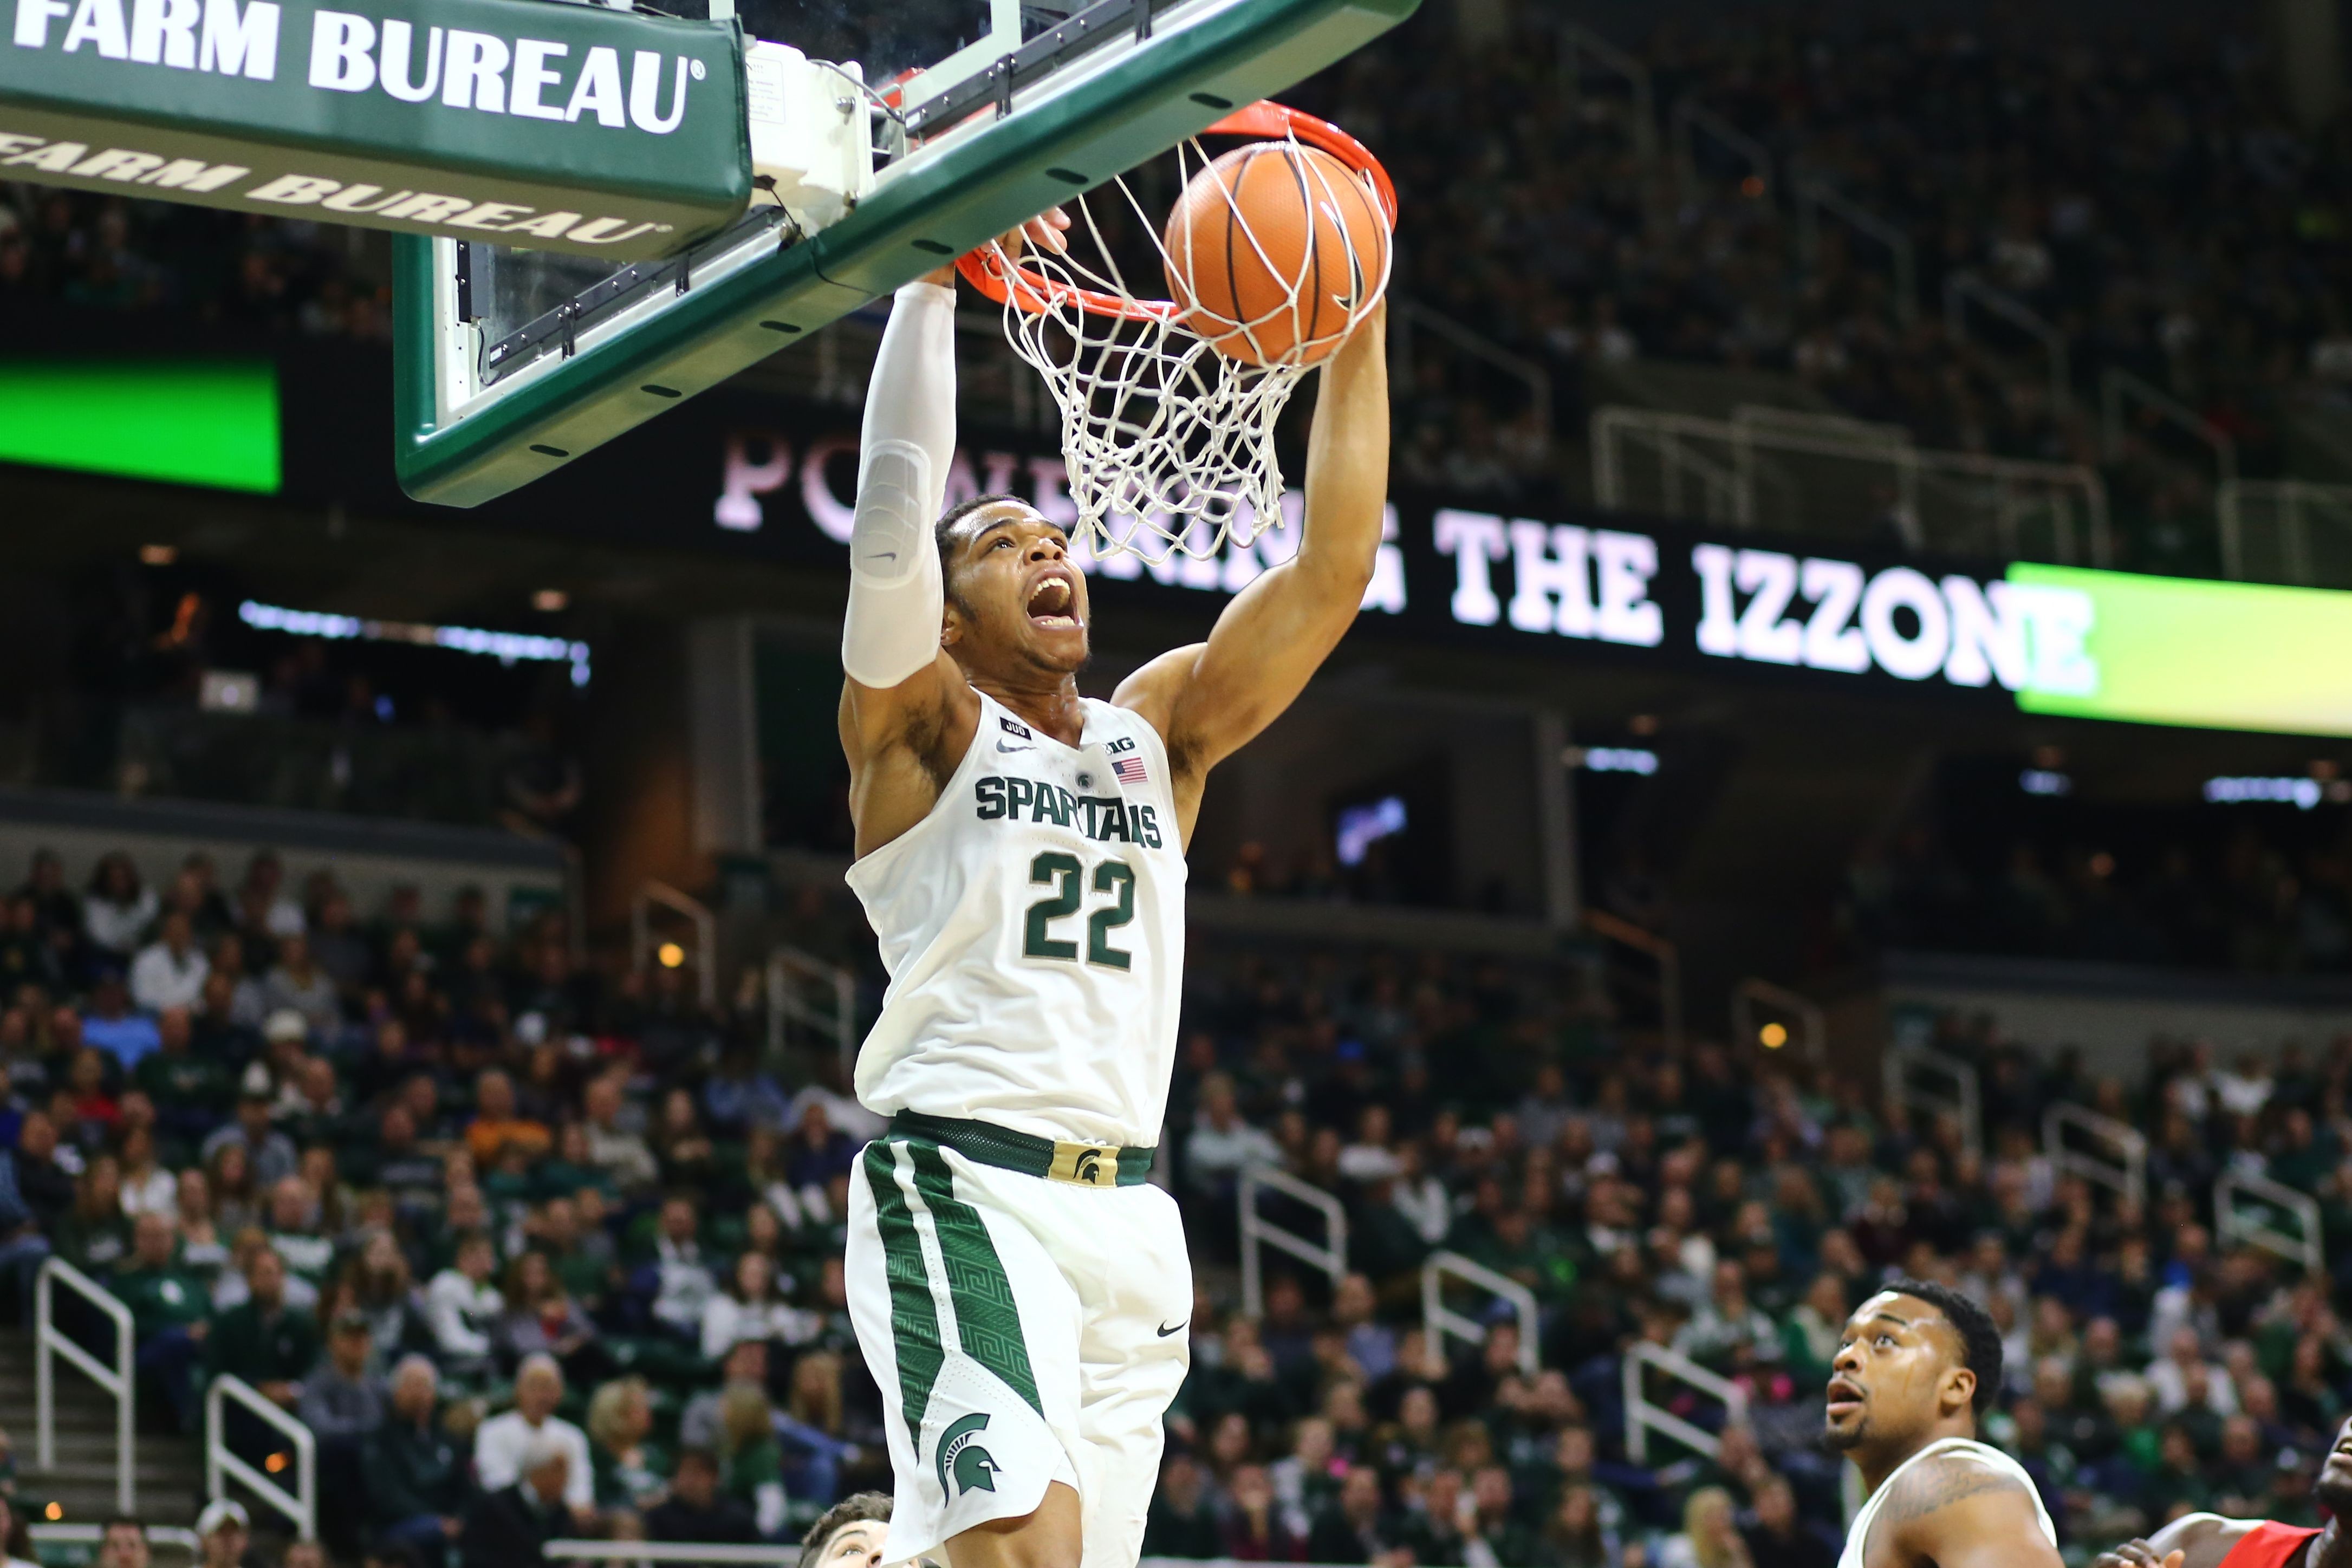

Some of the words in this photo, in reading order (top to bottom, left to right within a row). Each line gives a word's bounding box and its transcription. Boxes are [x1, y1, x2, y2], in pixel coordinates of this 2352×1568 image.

[14, 0, 281, 81] FARM
[1433, 508, 1664, 648] THE
[1691, 543, 2100, 697] IZZONE
[1006, 721, 1026, 737] JUD
[1022, 850, 1136, 973] 22
